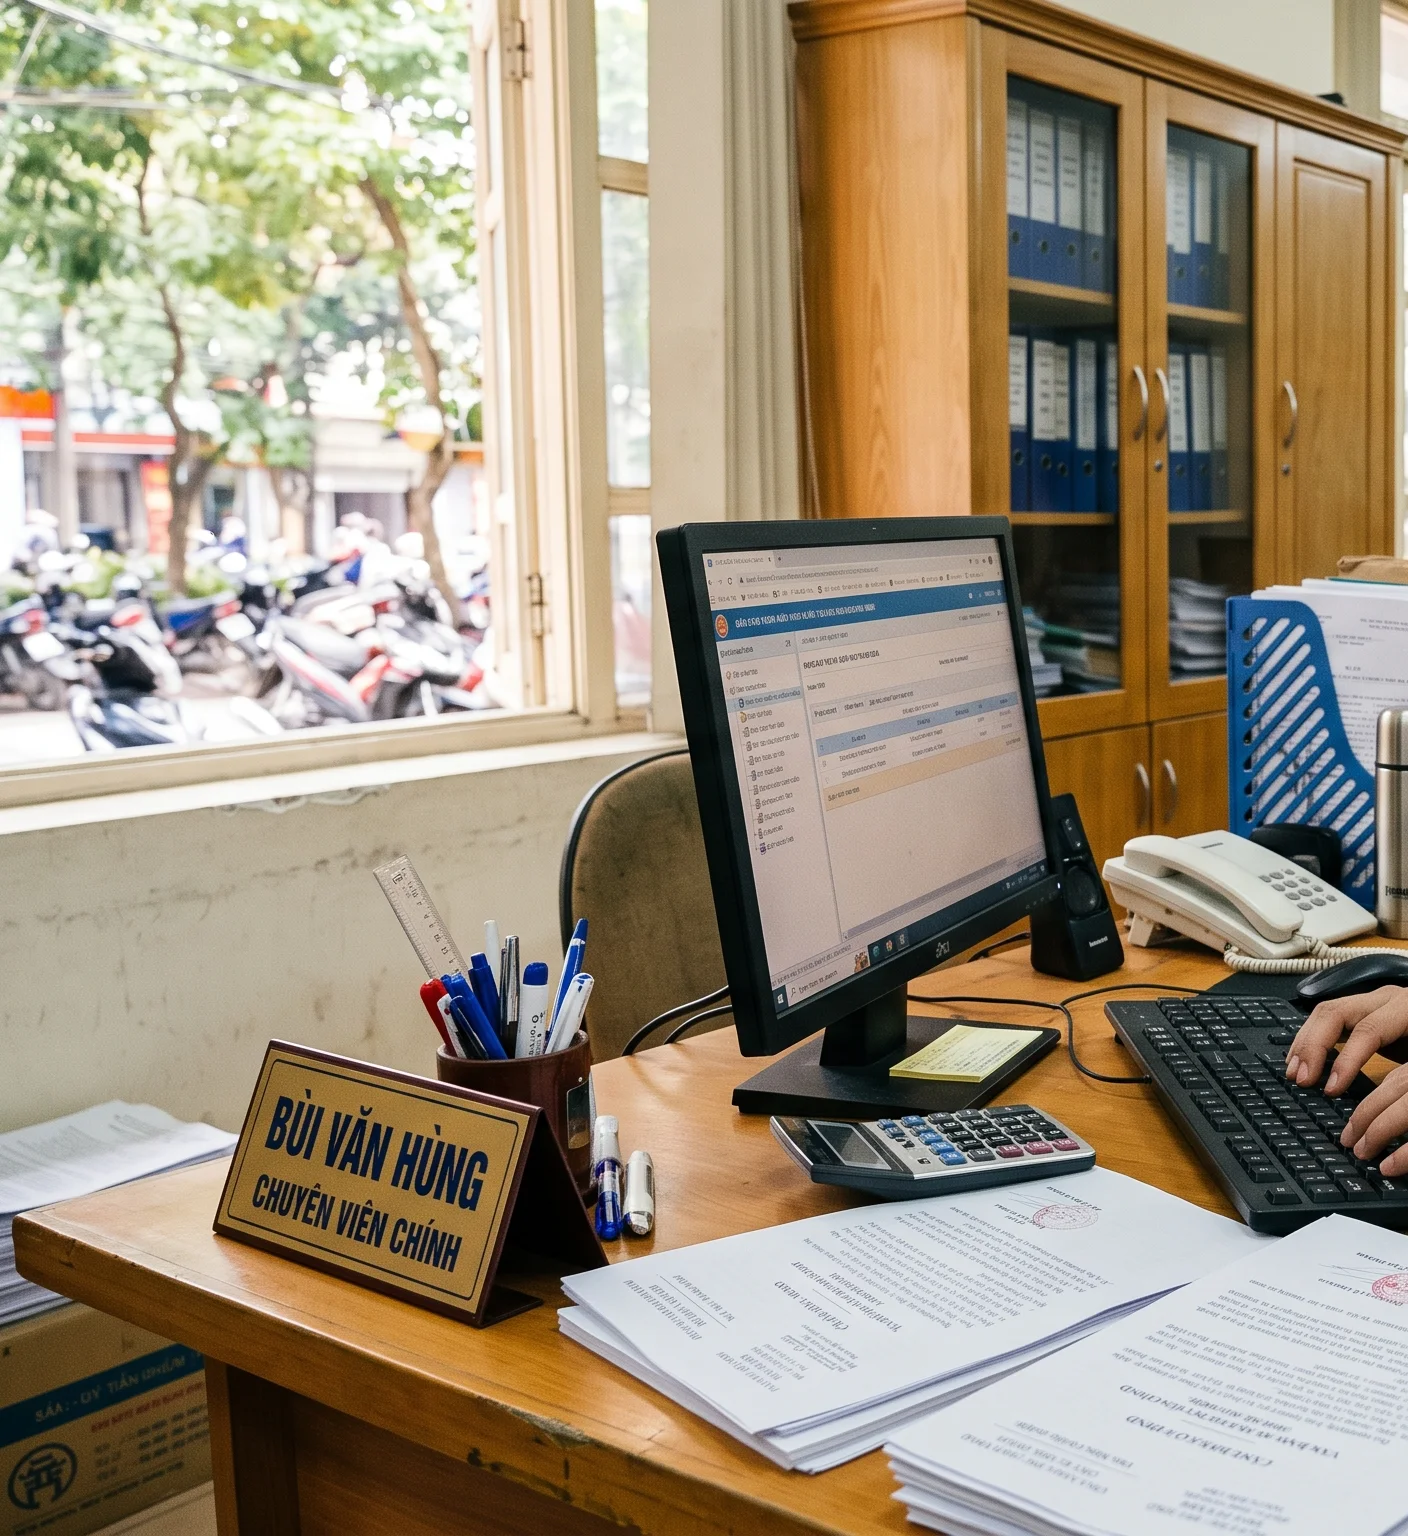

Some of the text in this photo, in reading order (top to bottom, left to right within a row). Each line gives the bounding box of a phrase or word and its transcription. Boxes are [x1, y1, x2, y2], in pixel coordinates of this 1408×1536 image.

[265, 1089, 489, 1211] BÙI VĂN HÙNG
[252, 1174, 462, 1273] CHUYÊN VIÊN CHÍNH
